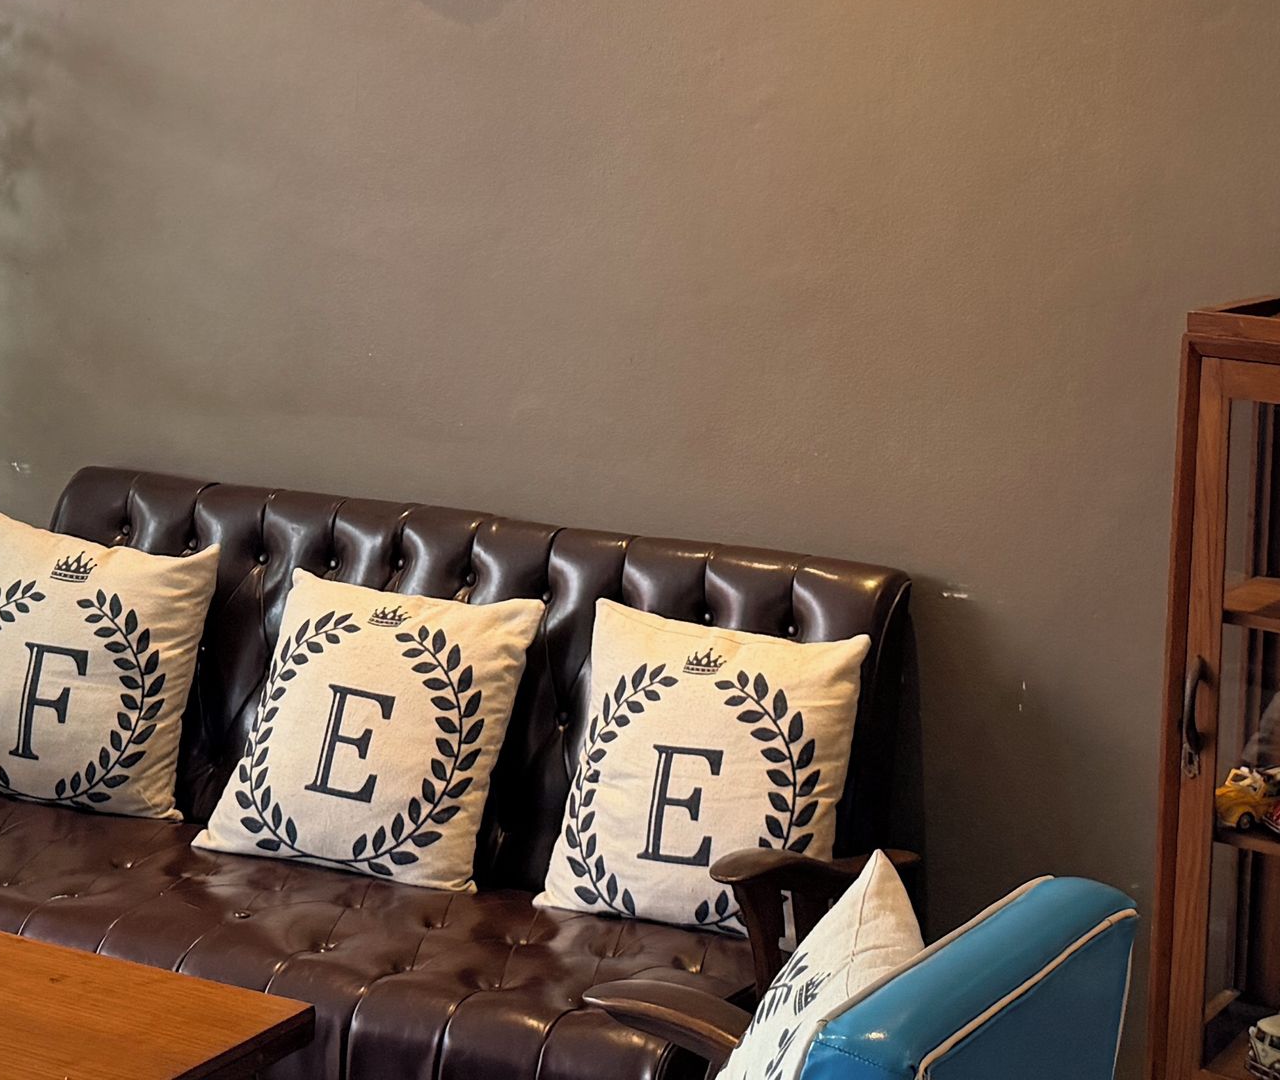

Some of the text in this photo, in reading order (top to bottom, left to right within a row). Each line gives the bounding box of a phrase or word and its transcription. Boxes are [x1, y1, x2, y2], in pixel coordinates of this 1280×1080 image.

[8, 640, 88, 760] F
[304, 684, 395, 804] E
[636, 744, 724, 868] E
